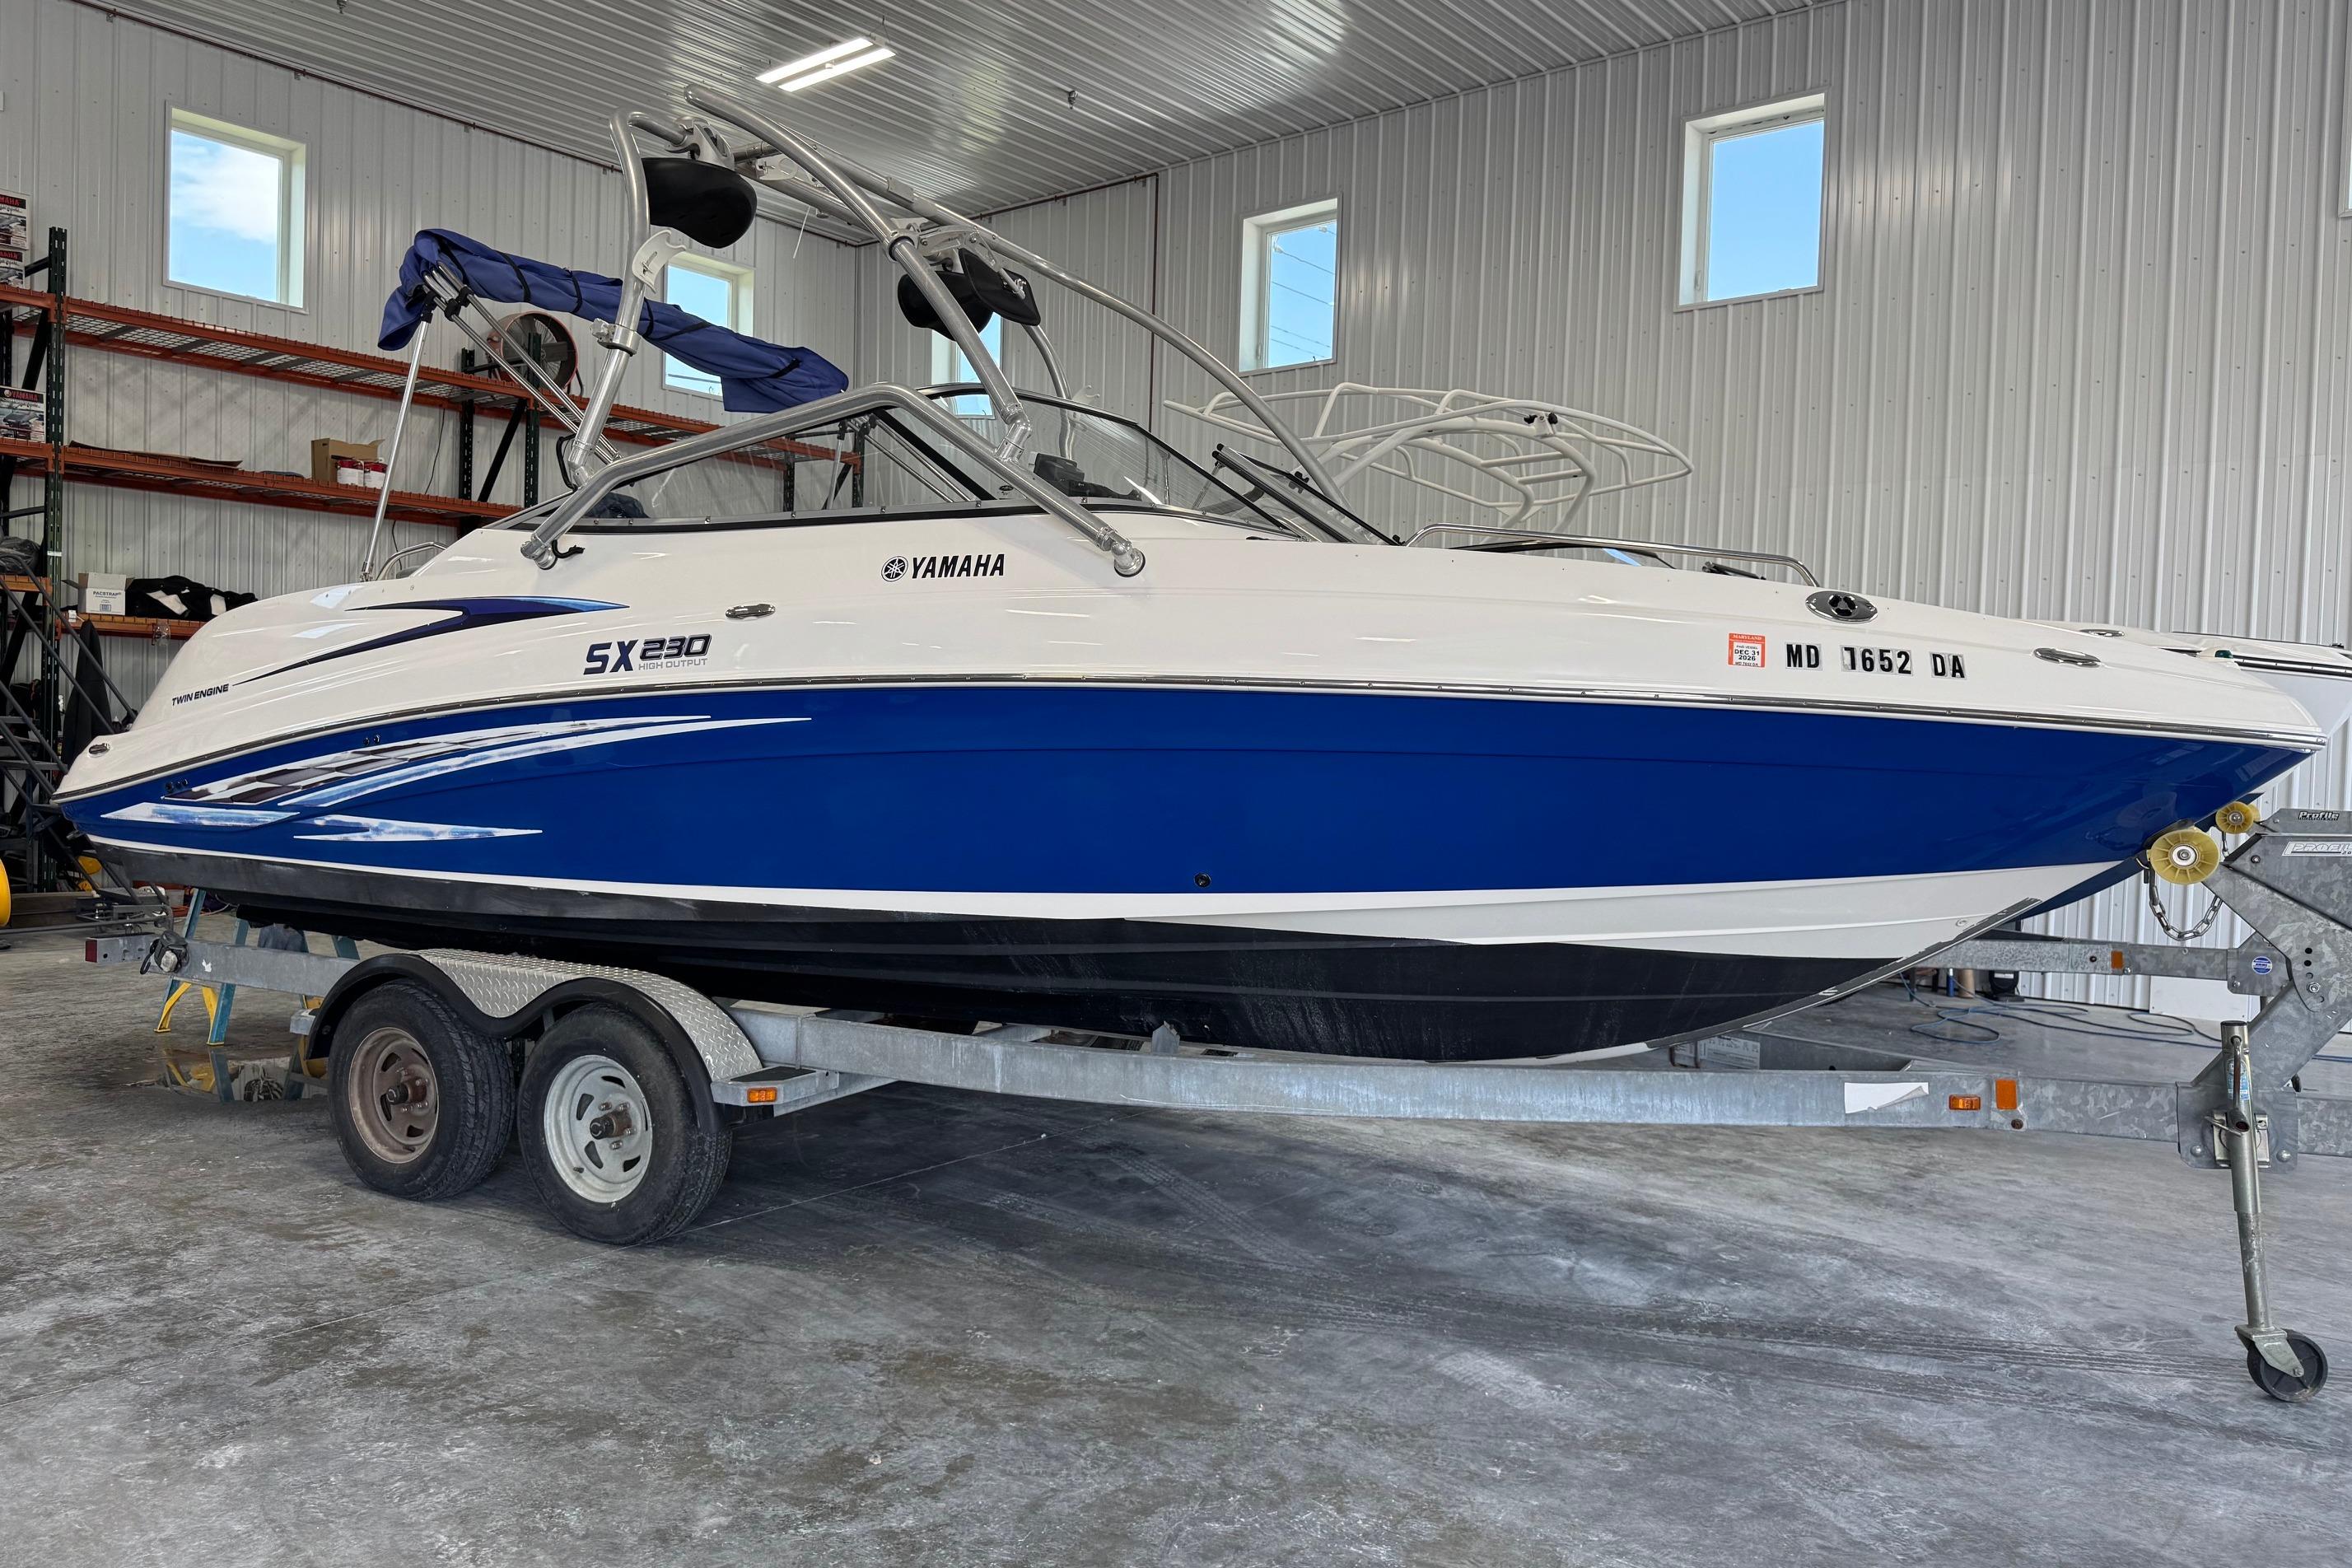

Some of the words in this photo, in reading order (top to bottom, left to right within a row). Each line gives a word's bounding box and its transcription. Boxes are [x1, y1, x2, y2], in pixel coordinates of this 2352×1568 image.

[912, 553, 1005, 579] YAMAHA
[583, 639, 638, 674] SX
[639, 633, 712, 661] 230
[638, 661, 663, 670] HIGH
[665, 658, 708, 669] OUTPUT
[1786, 643, 1819, 668] MD
[1844, 646, 1911, 674] 1652
[1932, 653, 1965, 678] DA
[172, 693, 193, 706] TWIN
[194, 684, 229, 700] ENGINE
[2298, 810, 2340, 820] Profile
